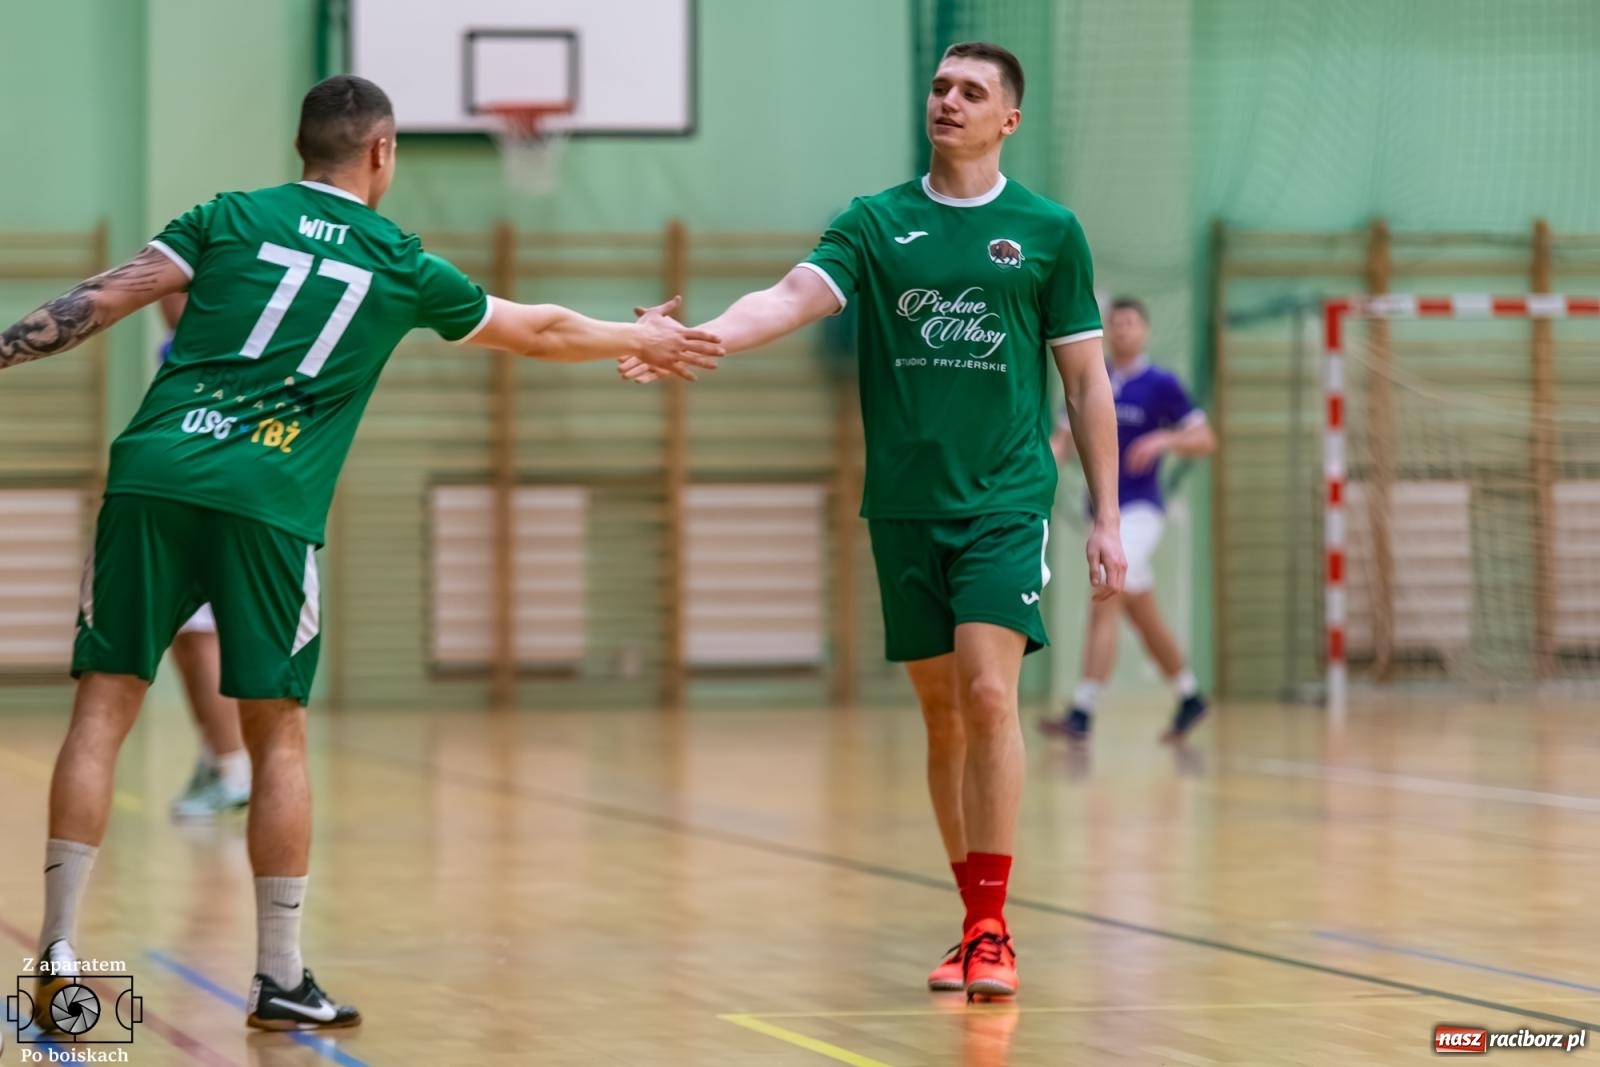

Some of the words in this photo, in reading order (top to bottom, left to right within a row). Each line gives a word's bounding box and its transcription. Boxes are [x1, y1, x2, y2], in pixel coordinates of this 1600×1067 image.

[298, 215, 350, 245] WITT
[238, 241, 374, 378] 77
[896, 286, 985, 321] Piękne
[920, 312, 1007, 359] Włosy
[895, 358, 927, 367] STUDIO
[933, 358, 1008, 373] FRYZJERSKIE
